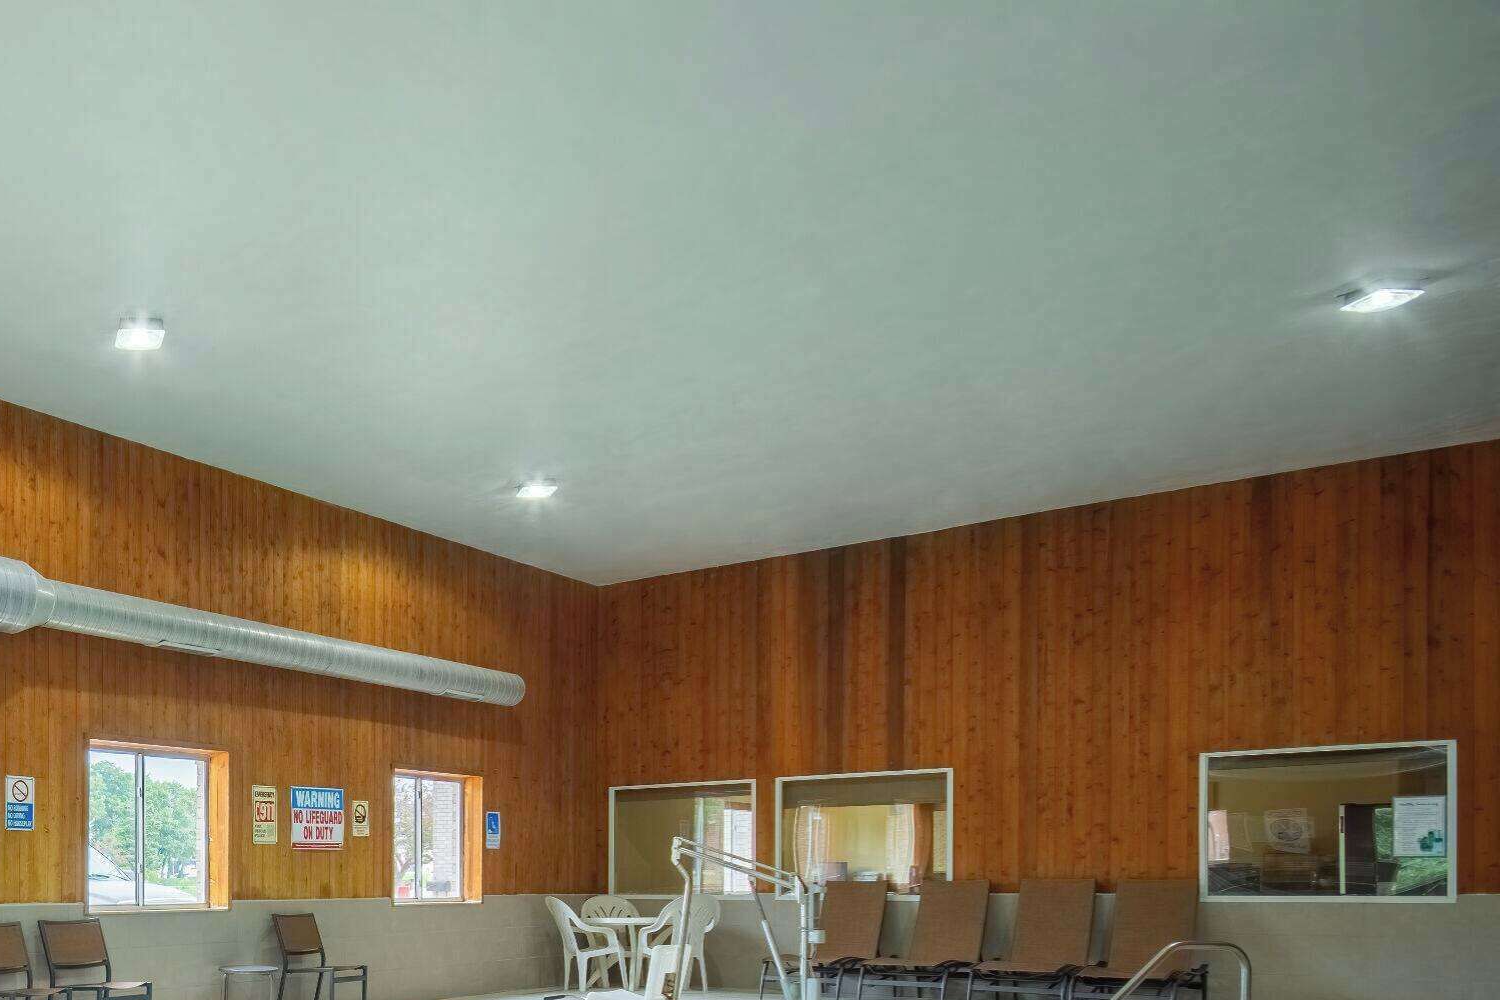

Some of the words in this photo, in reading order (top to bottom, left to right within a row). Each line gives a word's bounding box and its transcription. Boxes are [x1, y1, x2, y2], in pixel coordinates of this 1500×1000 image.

[296, 790, 340, 808] WARNING
[294, 810, 303, 824] NO
[306, 810, 342, 825] LIFEGUARD
[303, 826, 313, 840] ON
[316, 826, 334, 840] DUTY
